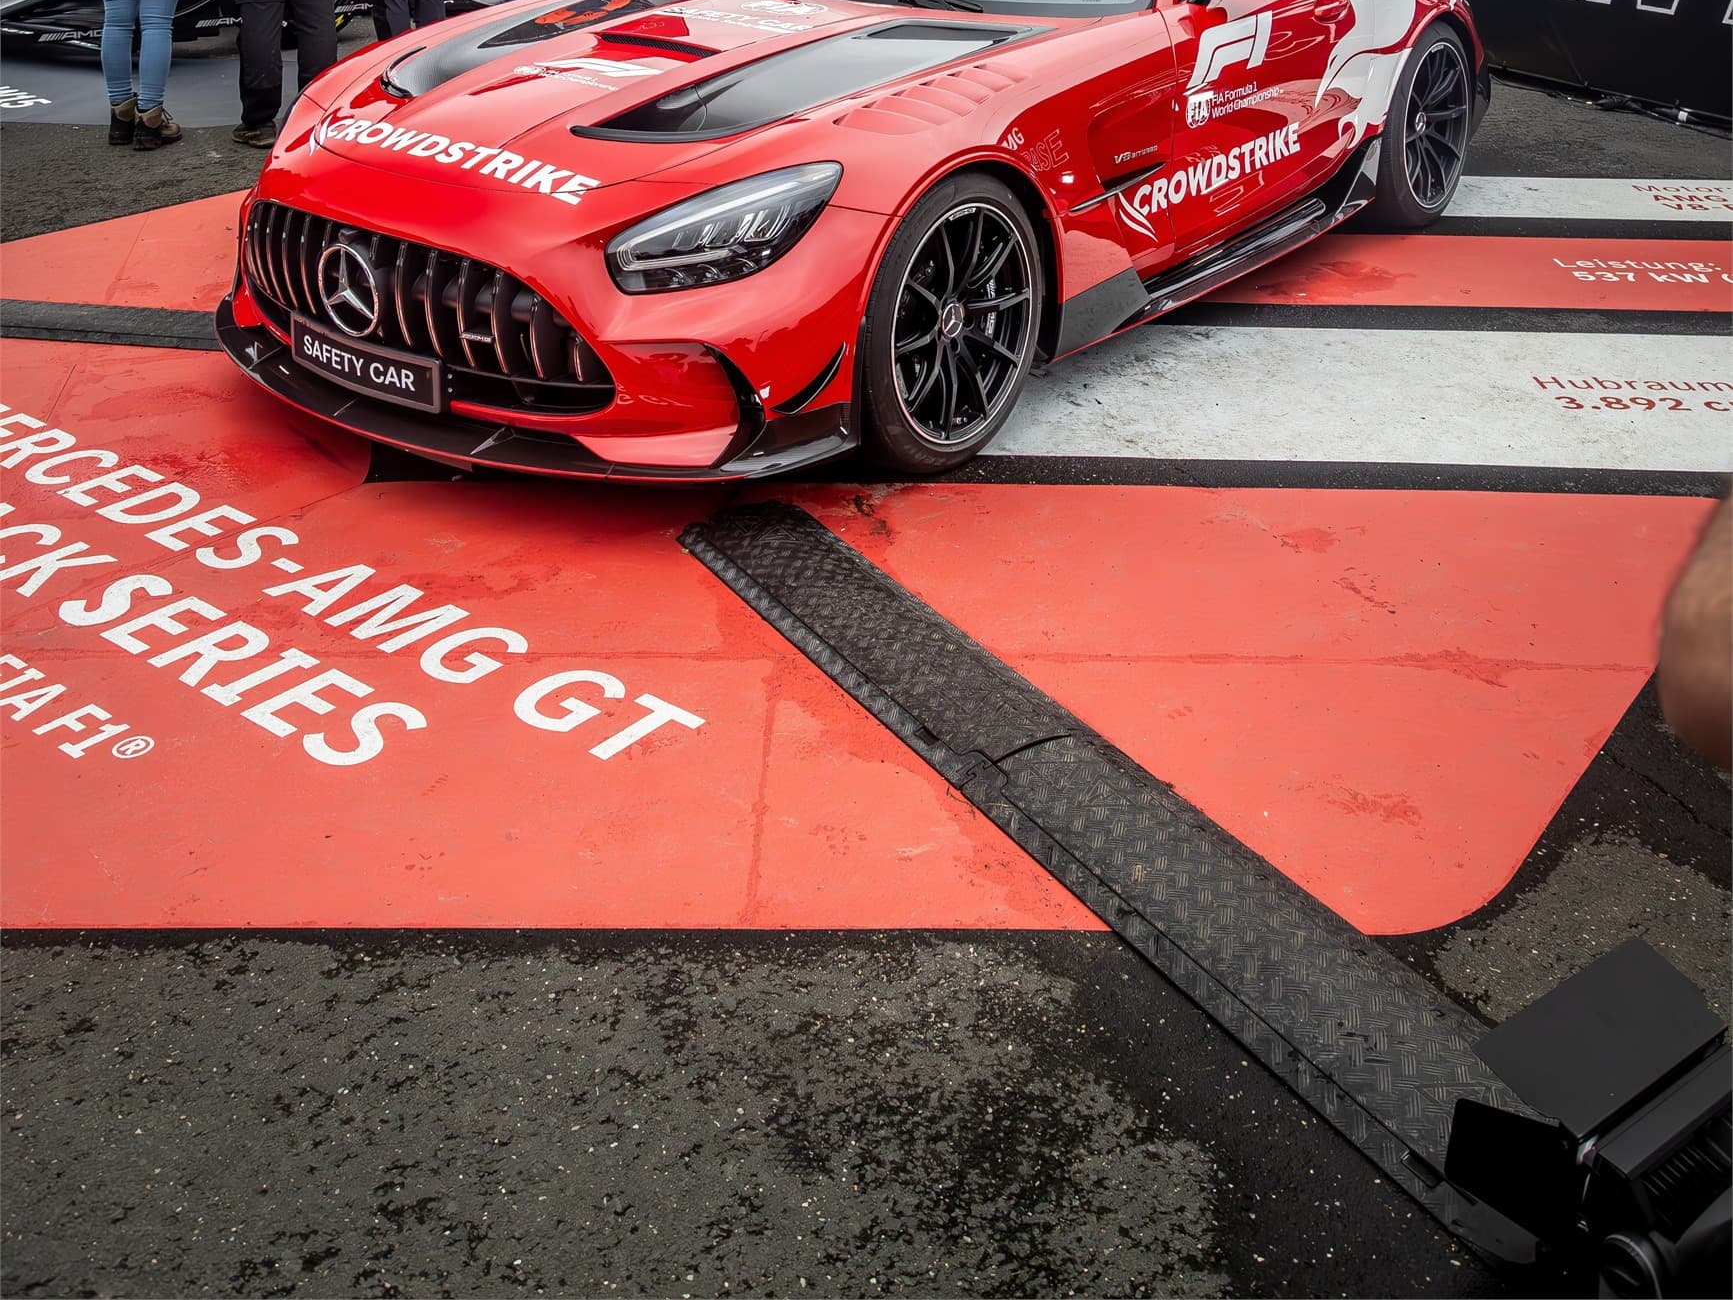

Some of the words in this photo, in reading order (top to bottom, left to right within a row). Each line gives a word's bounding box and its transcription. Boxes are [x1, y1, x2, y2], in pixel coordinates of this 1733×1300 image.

[1211, 93, 1225, 107] FIA
[1224, 83, 1253, 102] Formula
[1211, 101, 1234, 119] World
[327, 118, 601, 205] CROWDSTRIKE
[1132, 121, 1301, 217] CROWDSTRIKE
[1652, 194, 1729, 203] AMG
[1552, 257, 1722, 273] Leistung:
[1571, 270, 1637, 282] 537
[1647, 271, 1710, 284] kW
[303, 334, 364, 377] SAFETY
[369, 362, 416, 392] CAR
[1554, 395, 1692, 412] 3.892
[1703, 400, 1733, 412] c
[0, 402, 528, 685] RCEDES-AMG
[513, 669, 706, 761] GT
[0, 503, 118, 598] CK
[59, 573, 428, 766] SERIES
